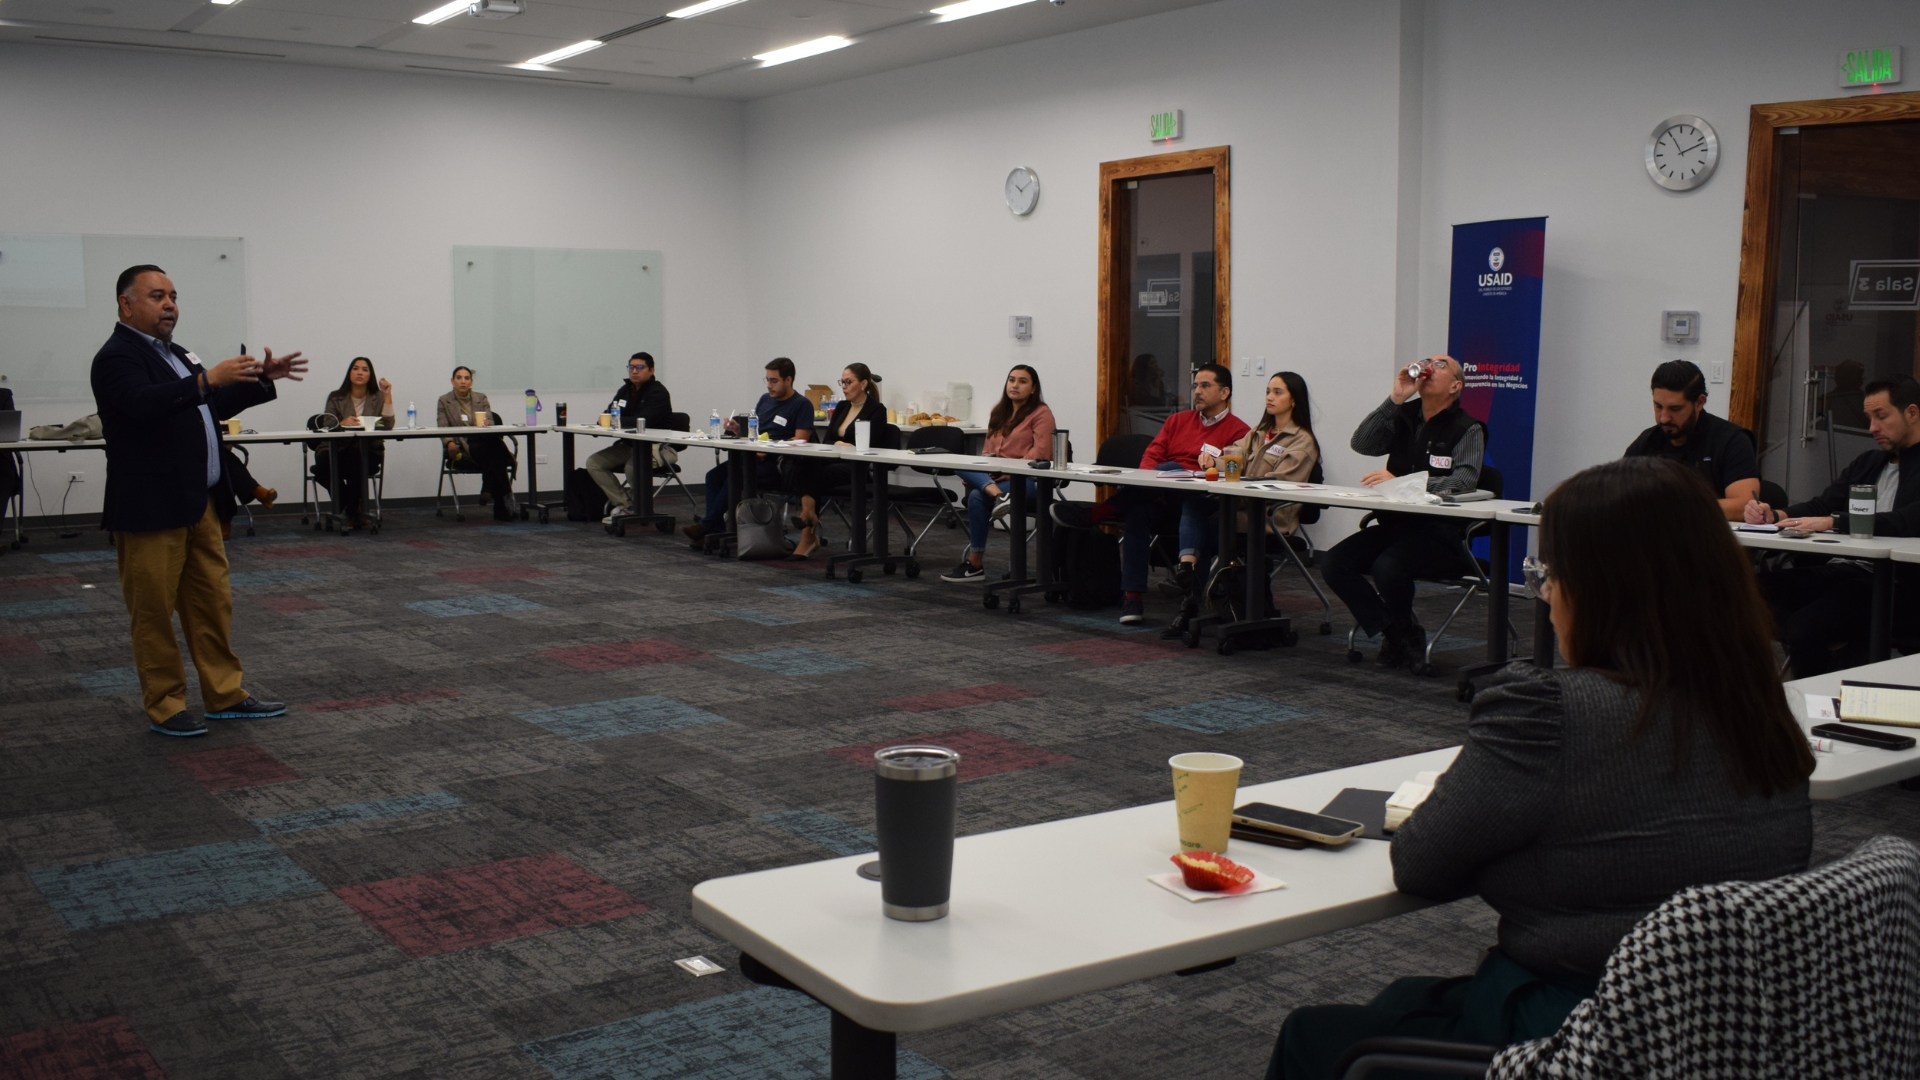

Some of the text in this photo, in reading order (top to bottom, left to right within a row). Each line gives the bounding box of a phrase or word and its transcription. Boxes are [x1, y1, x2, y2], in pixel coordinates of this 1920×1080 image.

[1846, 48, 1892, 83] SALIDA
[1150, 112, 1175, 138] SALIDA
[1478, 272, 1512, 287] USAID
[1463, 362, 1520, 374] ProIntegridad
[1494, 374, 1519, 382] Integridad
[1505, 382, 1528, 390] Negocios
[1430, 456, 1450, 467] PACO
